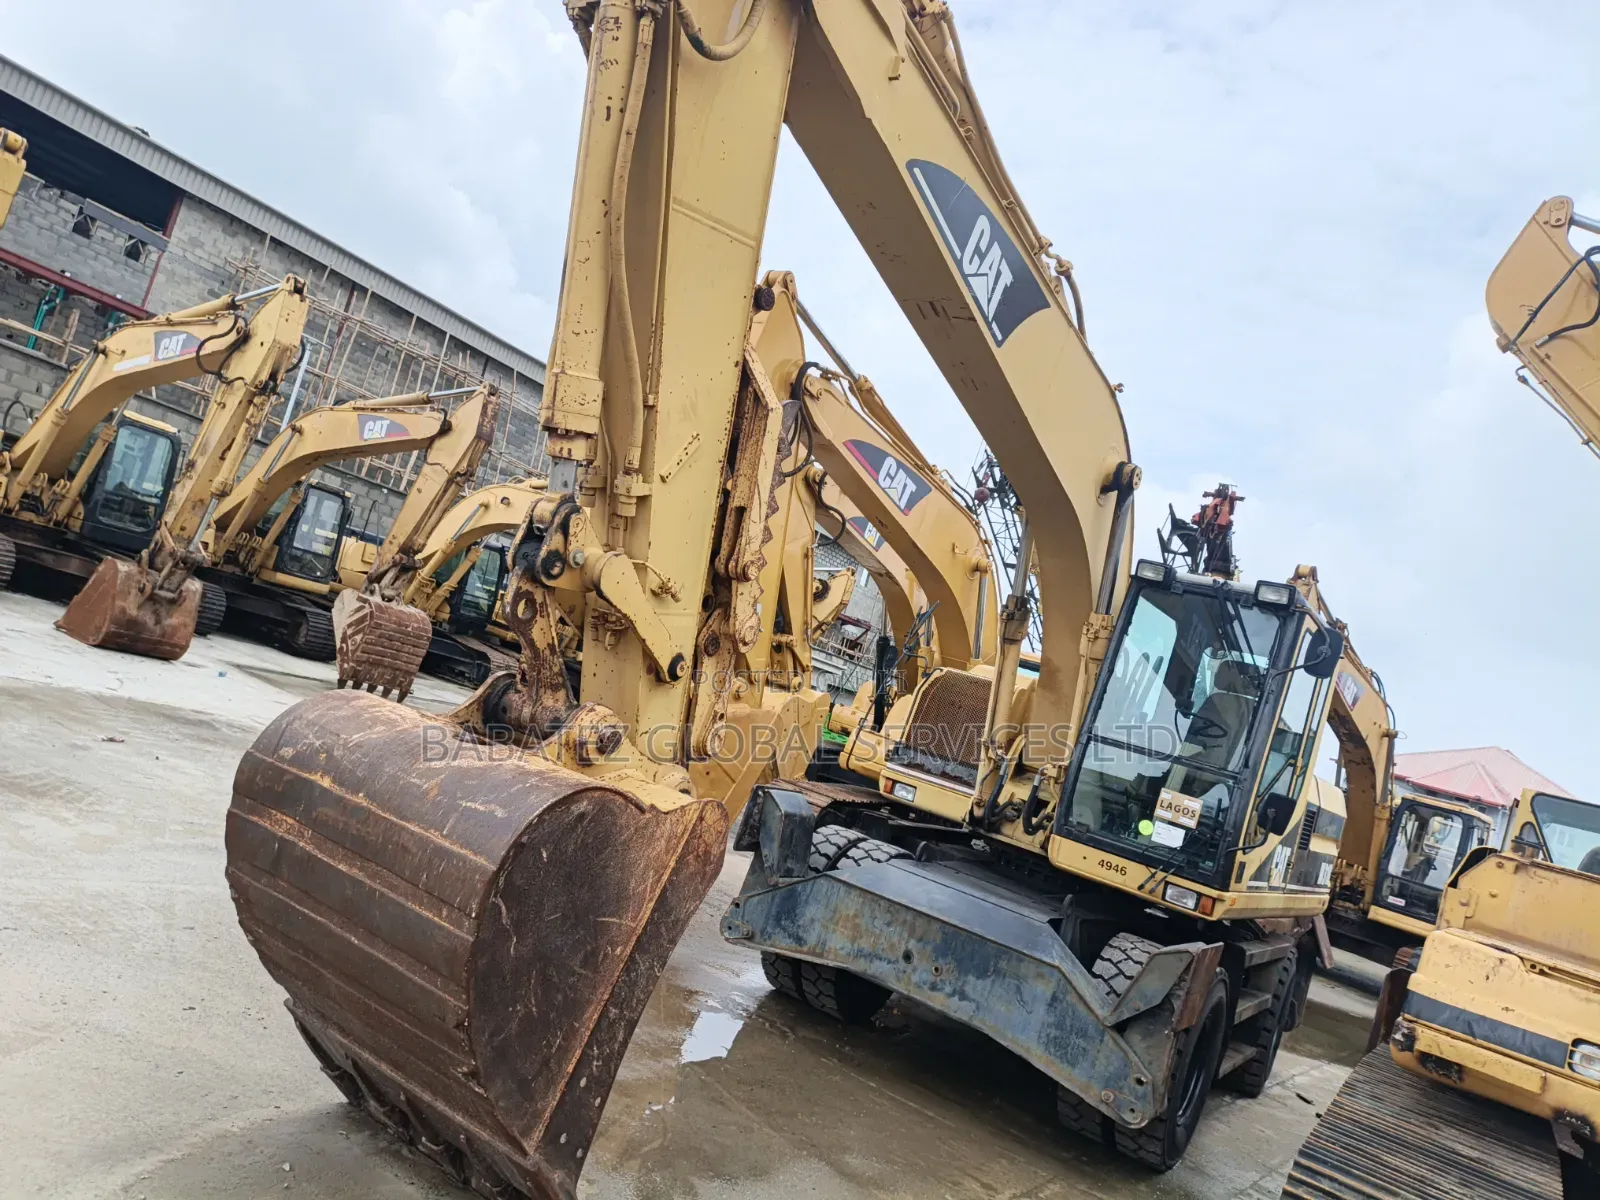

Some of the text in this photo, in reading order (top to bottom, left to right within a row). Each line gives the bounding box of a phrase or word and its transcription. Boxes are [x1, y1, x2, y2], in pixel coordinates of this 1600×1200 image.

[962, 214, 1013, 322] CAT
[157, 333, 187, 360] CAT
[363, 420, 390, 439] CAT
[878, 456, 917, 510] CAT
[1159, 799, 1197, 818] LAGOS
[1098, 859, 1127, 876] 4946
[1271, 844, 1292, 883] CAT
